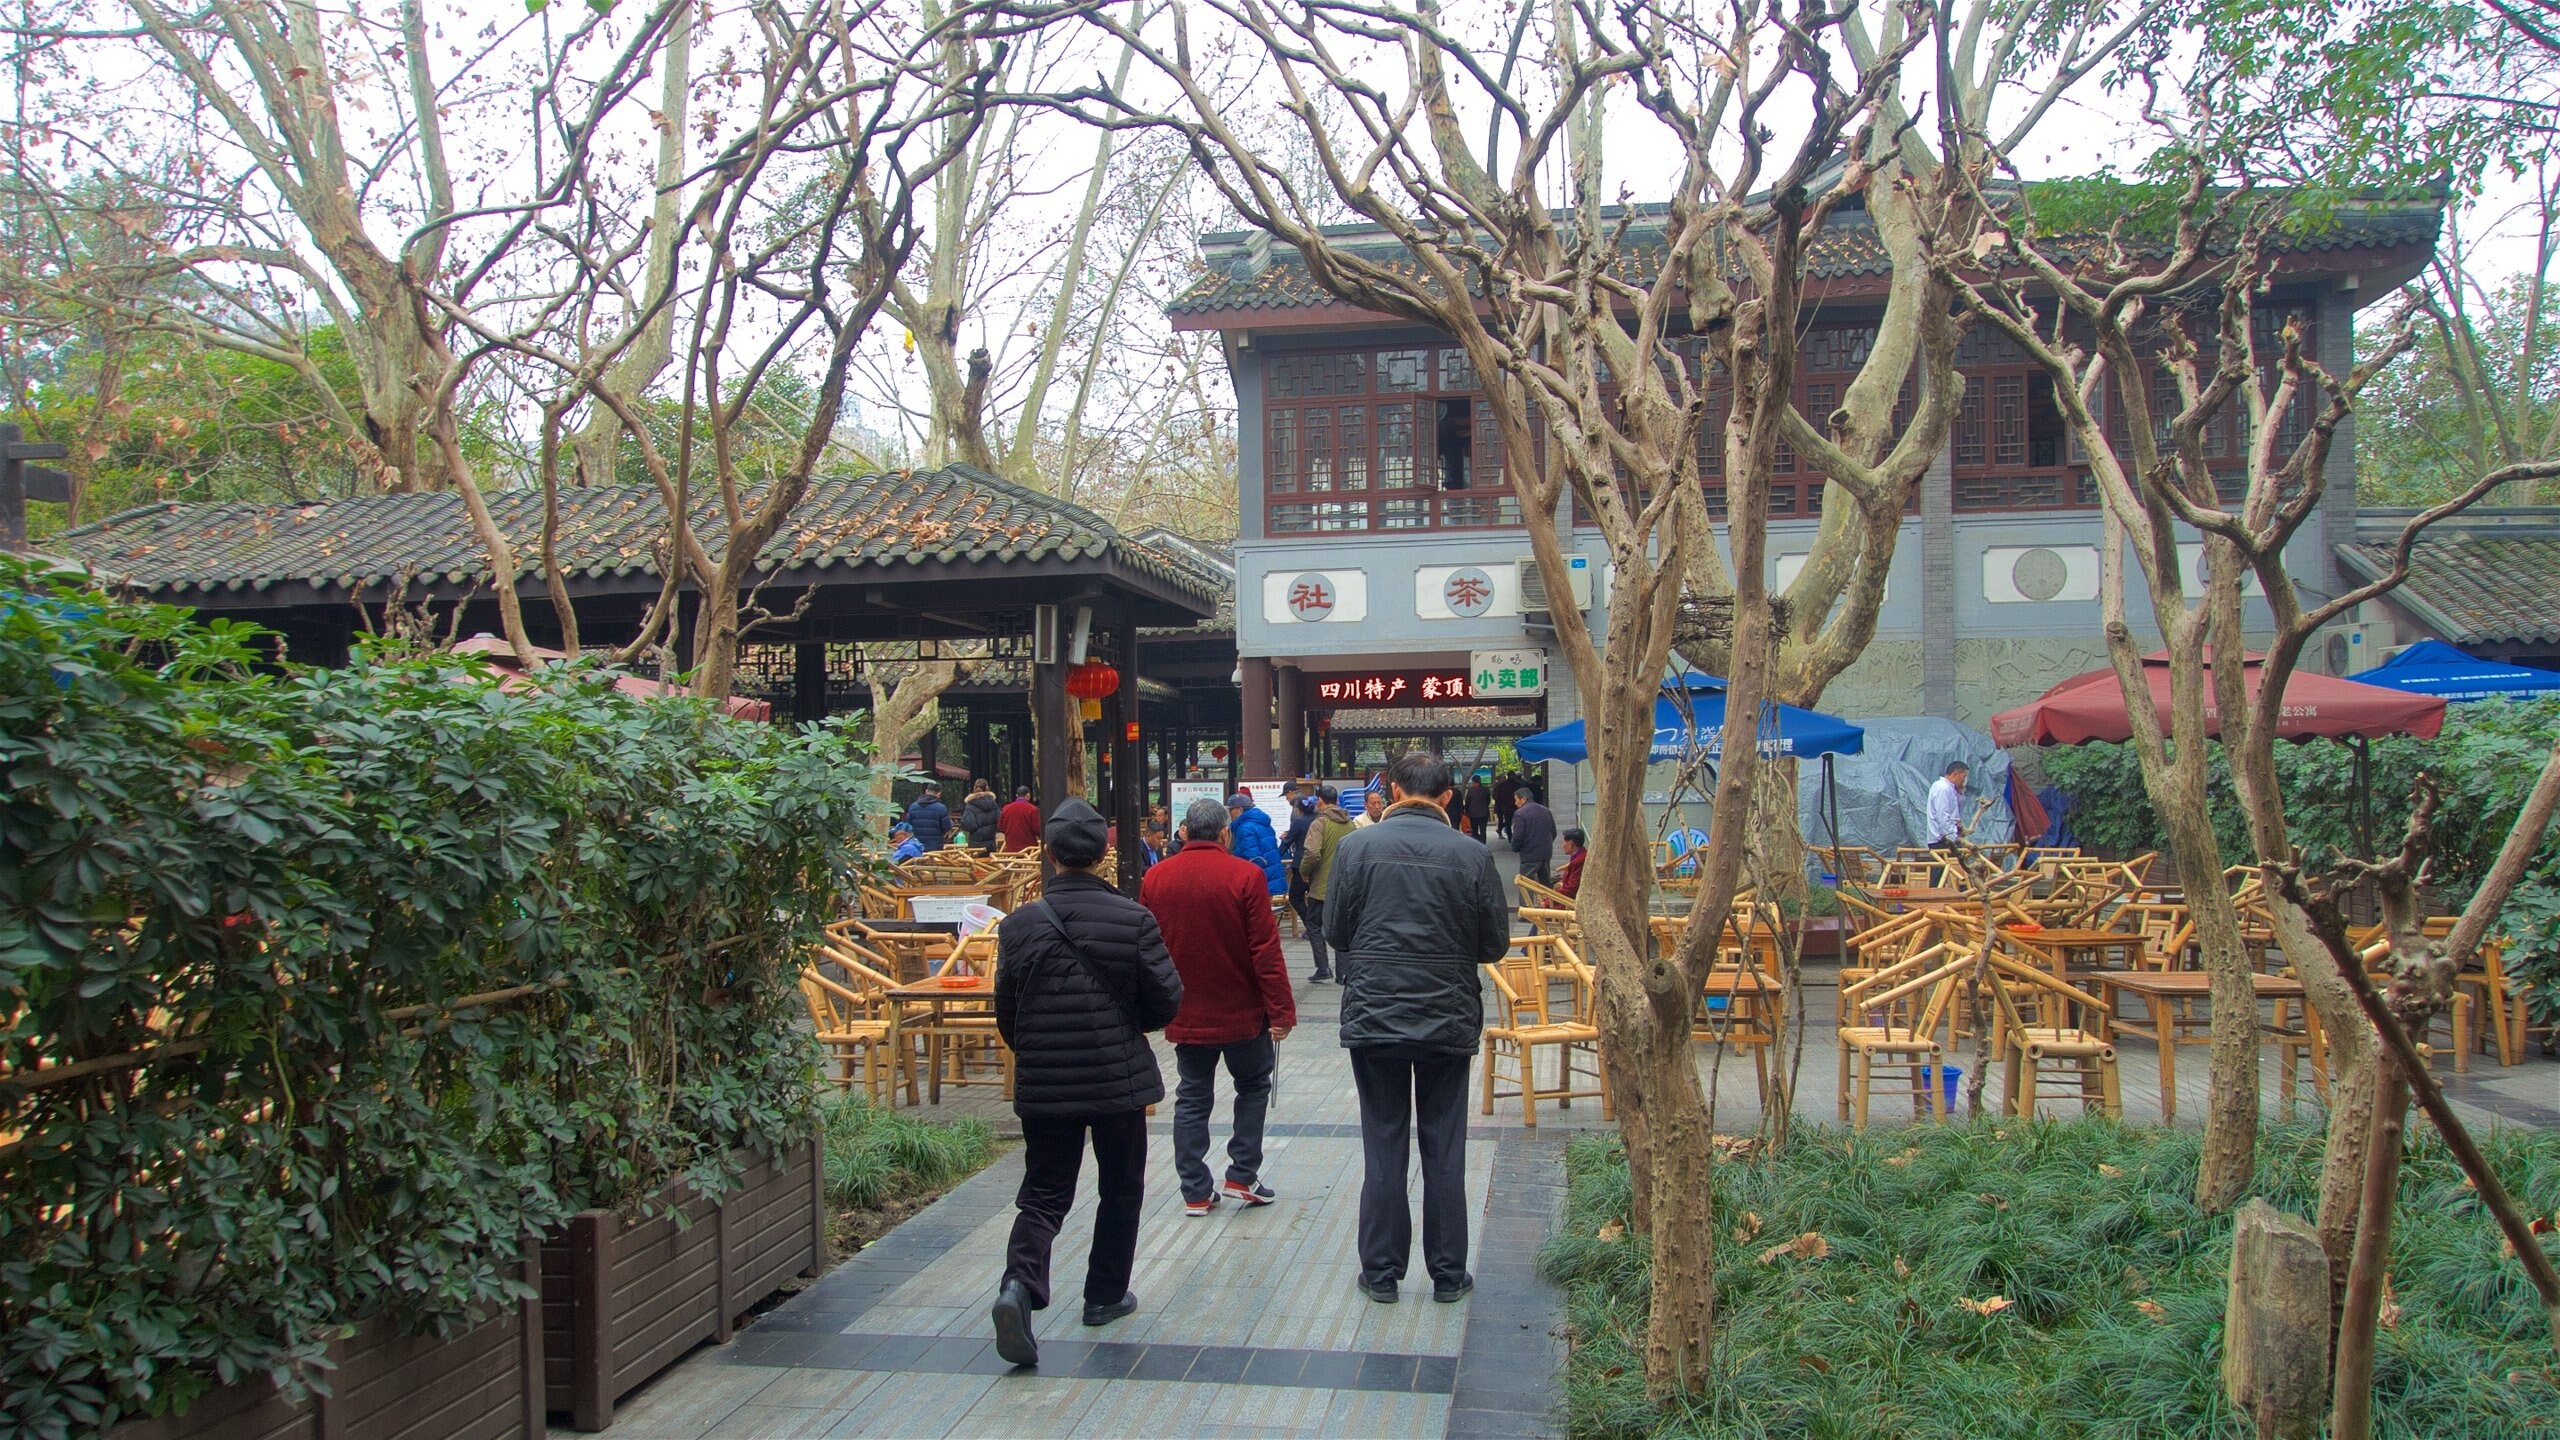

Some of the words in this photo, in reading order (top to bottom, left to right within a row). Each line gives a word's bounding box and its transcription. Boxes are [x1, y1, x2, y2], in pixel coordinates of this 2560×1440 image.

[1290, 583, 1332, 611] 社
[1447, 578, 1490, 607] 茶
[1320, 677, 1407, 700] 四川特产
[1476, 668, 1539, 689] 小卖部
